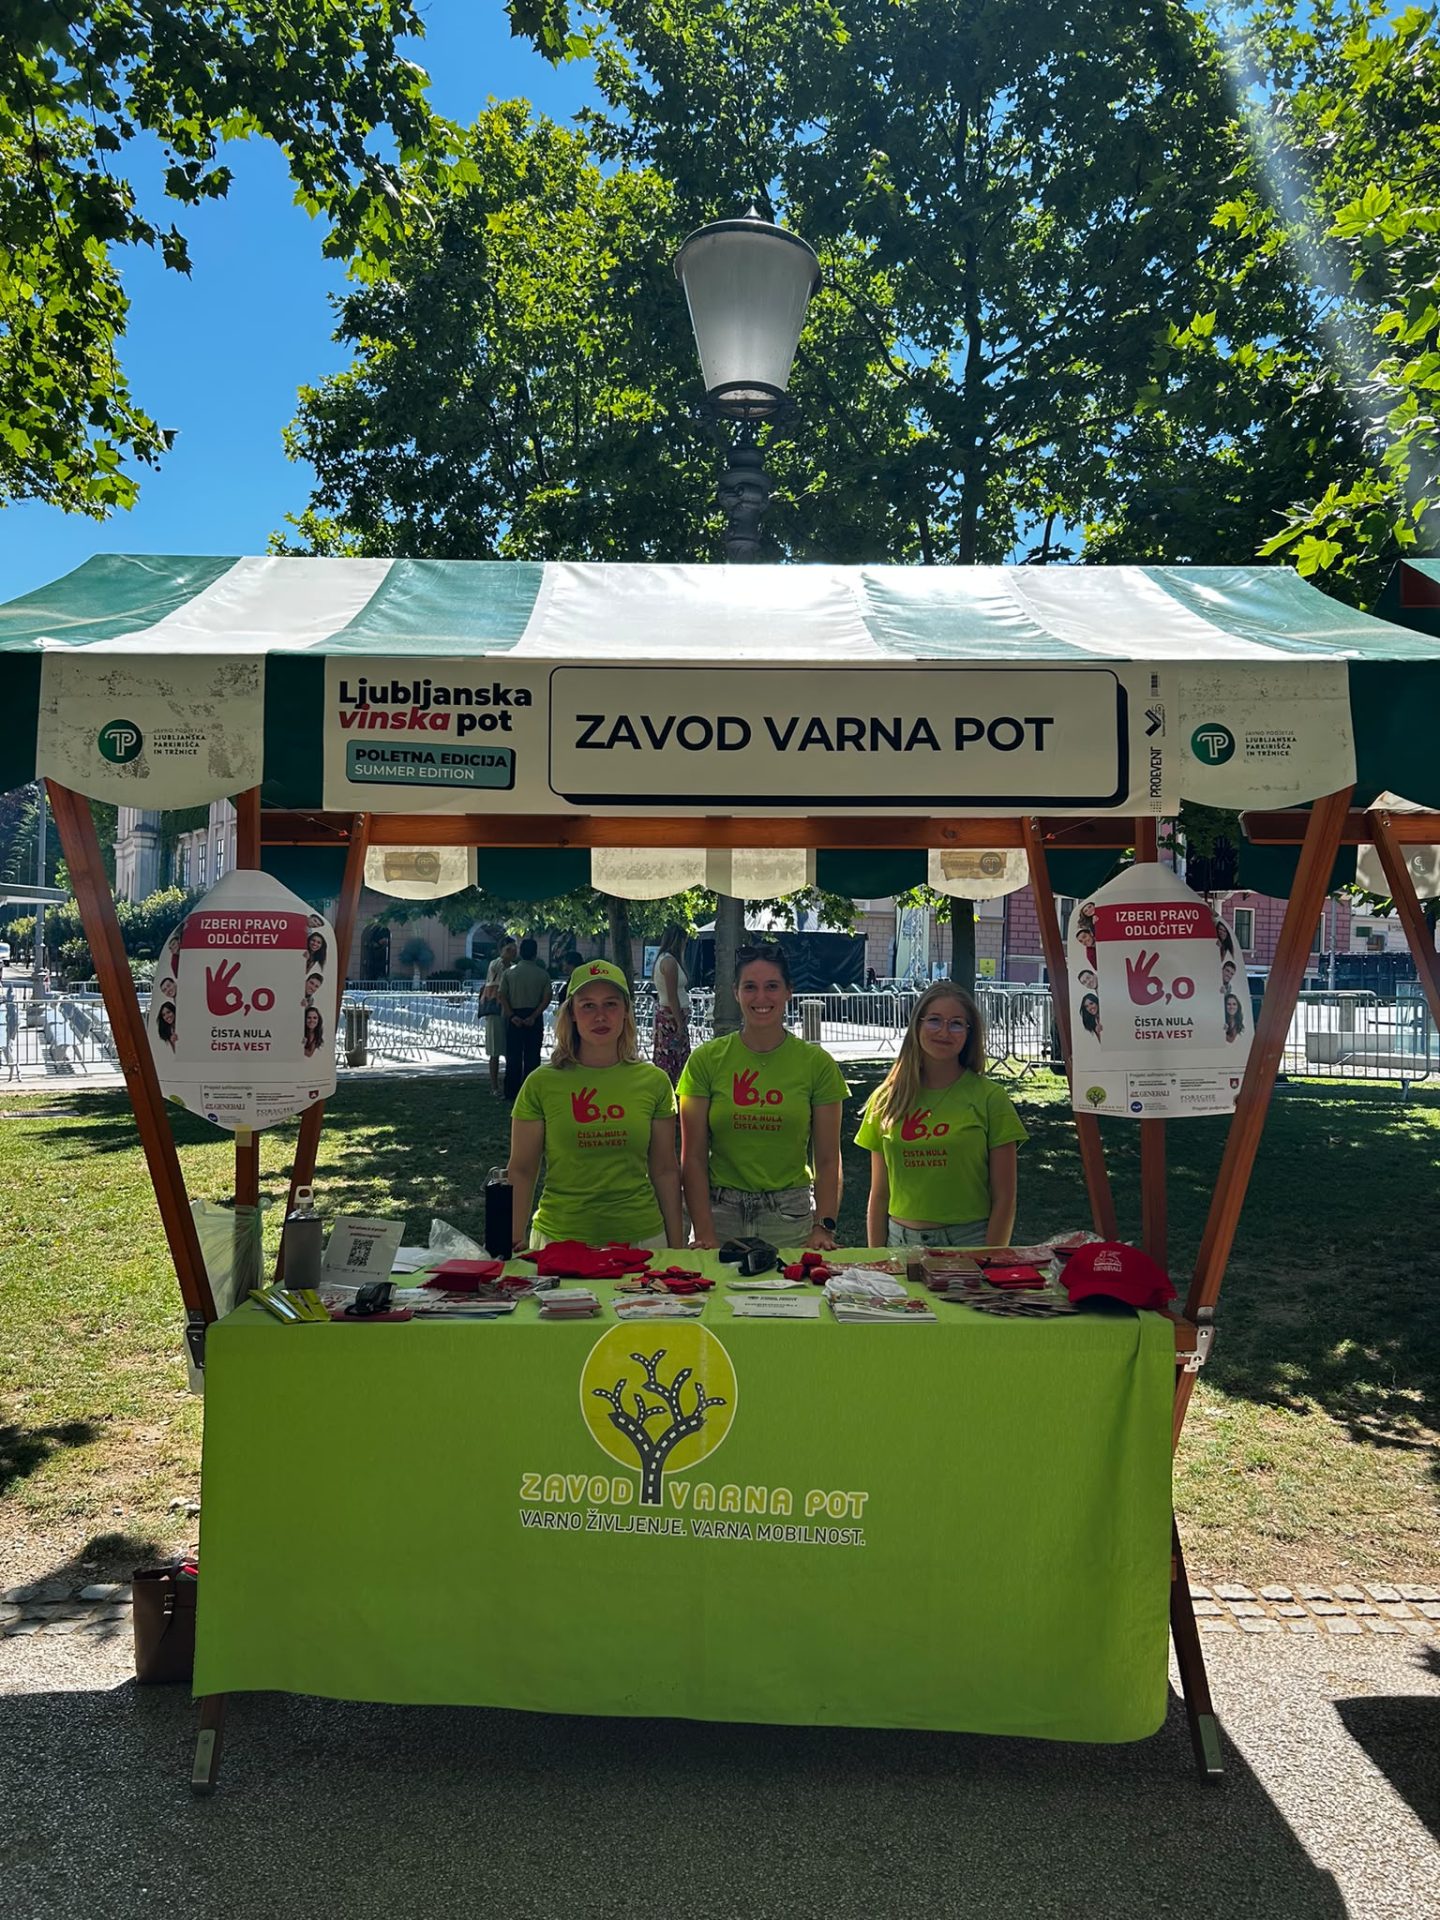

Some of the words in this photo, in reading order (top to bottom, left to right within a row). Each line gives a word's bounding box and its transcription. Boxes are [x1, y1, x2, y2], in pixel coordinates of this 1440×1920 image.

[339, 677, 532, 710] Ljubljanska
[338, 703, 451, 731] vinska
[456, 710, 513, 737] pot
[575, 714, 752, 751] ZAVOD
[763, 716, 941, 751] VARNA
[954, 716, 1054, 751] POT
[153, 740, 200, 748] PARKIRIŠČA
[355, 748, 435, 765] POLETNA
[440, 753, 508, 768] EDICIJA
[354, 764, 415, 777] SUMMER
[419, 766, 475, 780] EDITION
[1150, 746, 1162, 798] PROEVENT
[1115, 910, 1157, 923] IZBERI
[1160, 909, 1200, 921] PRAVO
[200, 918, 241, 930] IZBERI
[245, 918, 288, 930] PRAVO
[1125, 921, 1194, 936] ODLOČITEV
[207, 931, 279, 945] ODLOČITEV
[1134, 1016, 1164, 1027] ČISTA
[1165, 1017, 1194, 1027] NULA
[210, 1026, 241, 1038] ČISTA
[243, 1029, 272, 1038] NULA
[1135, 1028, 1164, 1040] ČISTA
[1166, 1029, 1193, 1039] VEST
[210, 1040, 241, 1051] ČISTA
[243, 1042, 271, 1051] VEST
[733, 1112, 757, 1121] ČISTA
[760, 1114, 783, 1122] NULA
[733, 1121, 757, 1130] ČISTA
[760, 1123, 782, 1131] VEST
[577, 1129, 600, 1139] ČISTA
[602, 1130, 628, 1138] NULA
[578, 1138, 601, 1148] ČISTA
[604, 1139, 628, 1147] VEST
[903, 1148, 925, 1157] ČISTA
[903, 1158, 926, 1168] ČISTA
[927, 1159, 947, 1167] VEST
[520, 1472, 634, 1505] ZAVOD
[669, 1481, 793, 1515] VARNA
[805, 1489, 869, 1519] POT
[519, 1509, 582, 1530] VARNO
[586, 1508, 687, 1536] ŽIVLJENJE.
[691, 1519, 752, 1540] VARNA
[756, 1524, 866, 1546] MOBILNOST.
